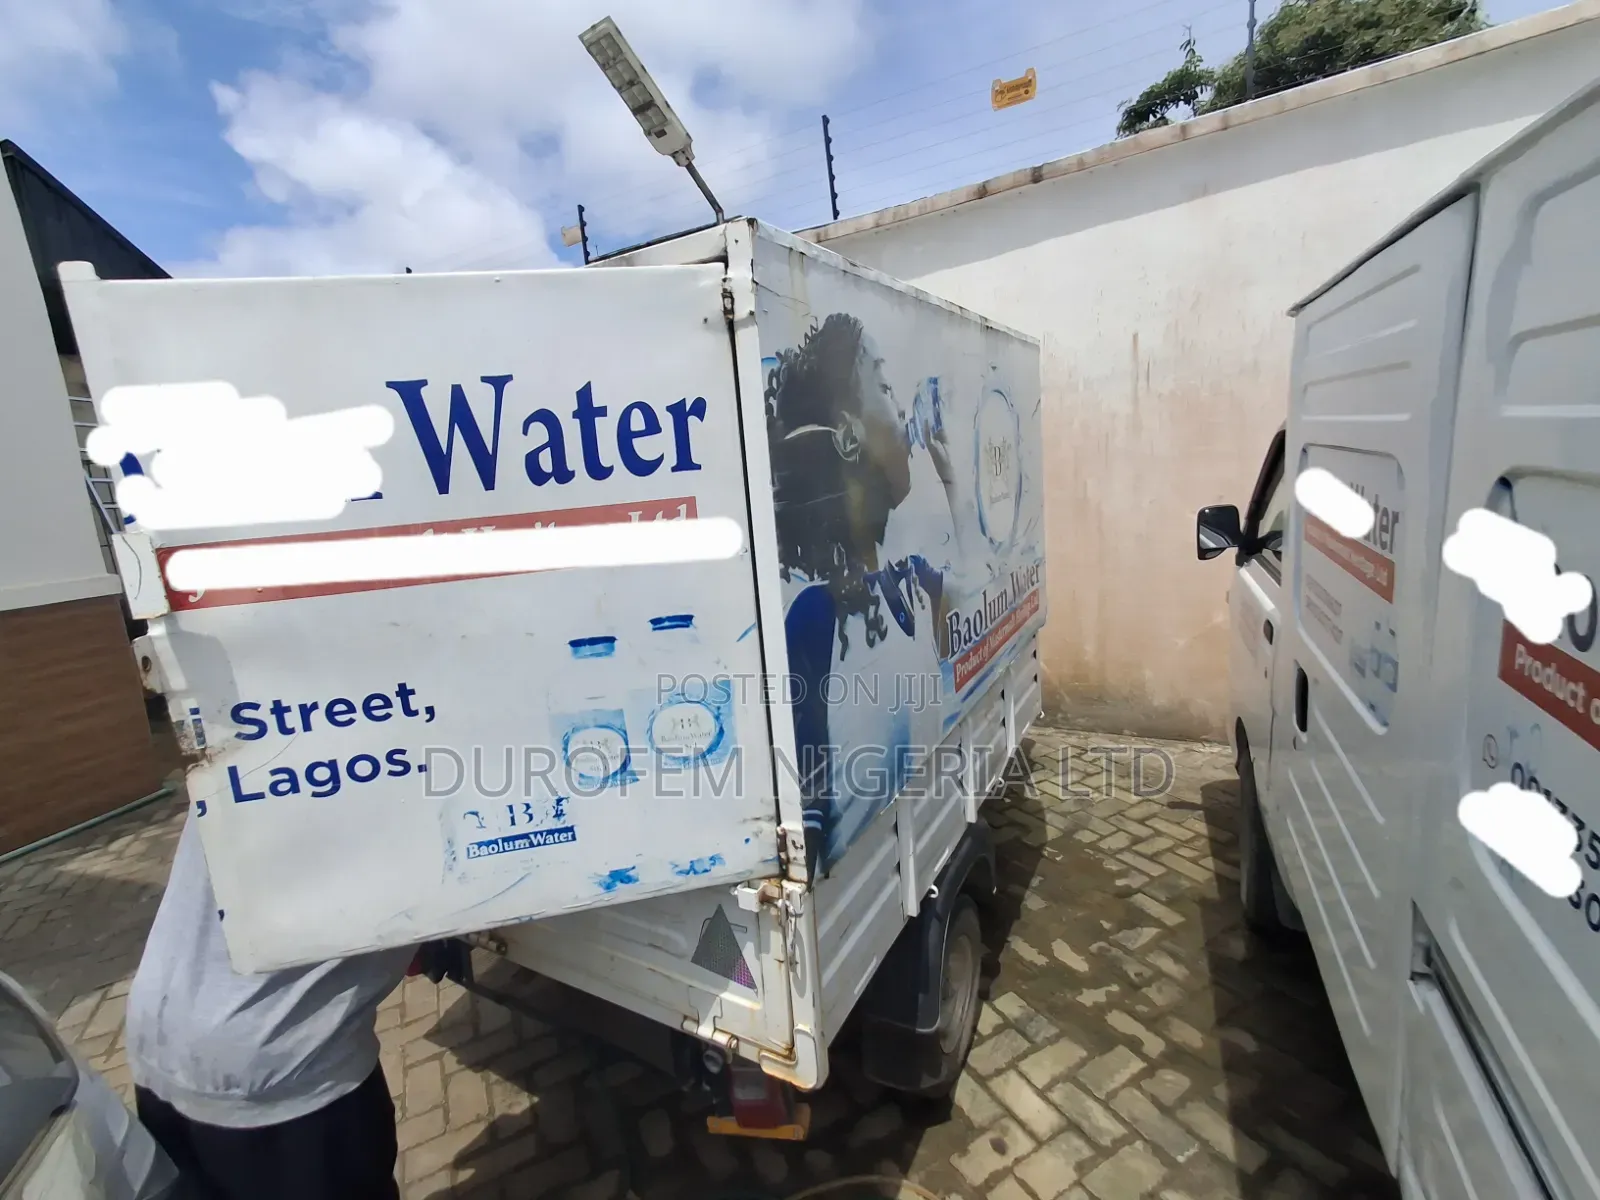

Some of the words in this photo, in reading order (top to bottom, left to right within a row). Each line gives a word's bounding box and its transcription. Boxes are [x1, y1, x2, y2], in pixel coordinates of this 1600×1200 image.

[385, 374, 707, 496] Water
[947, 589, 1009, 660] Baolum
[230, 682, 436, 741] Street,
[1515, 642, 1586, 714] Product
[227, 747, 427, 803] Lagos.
